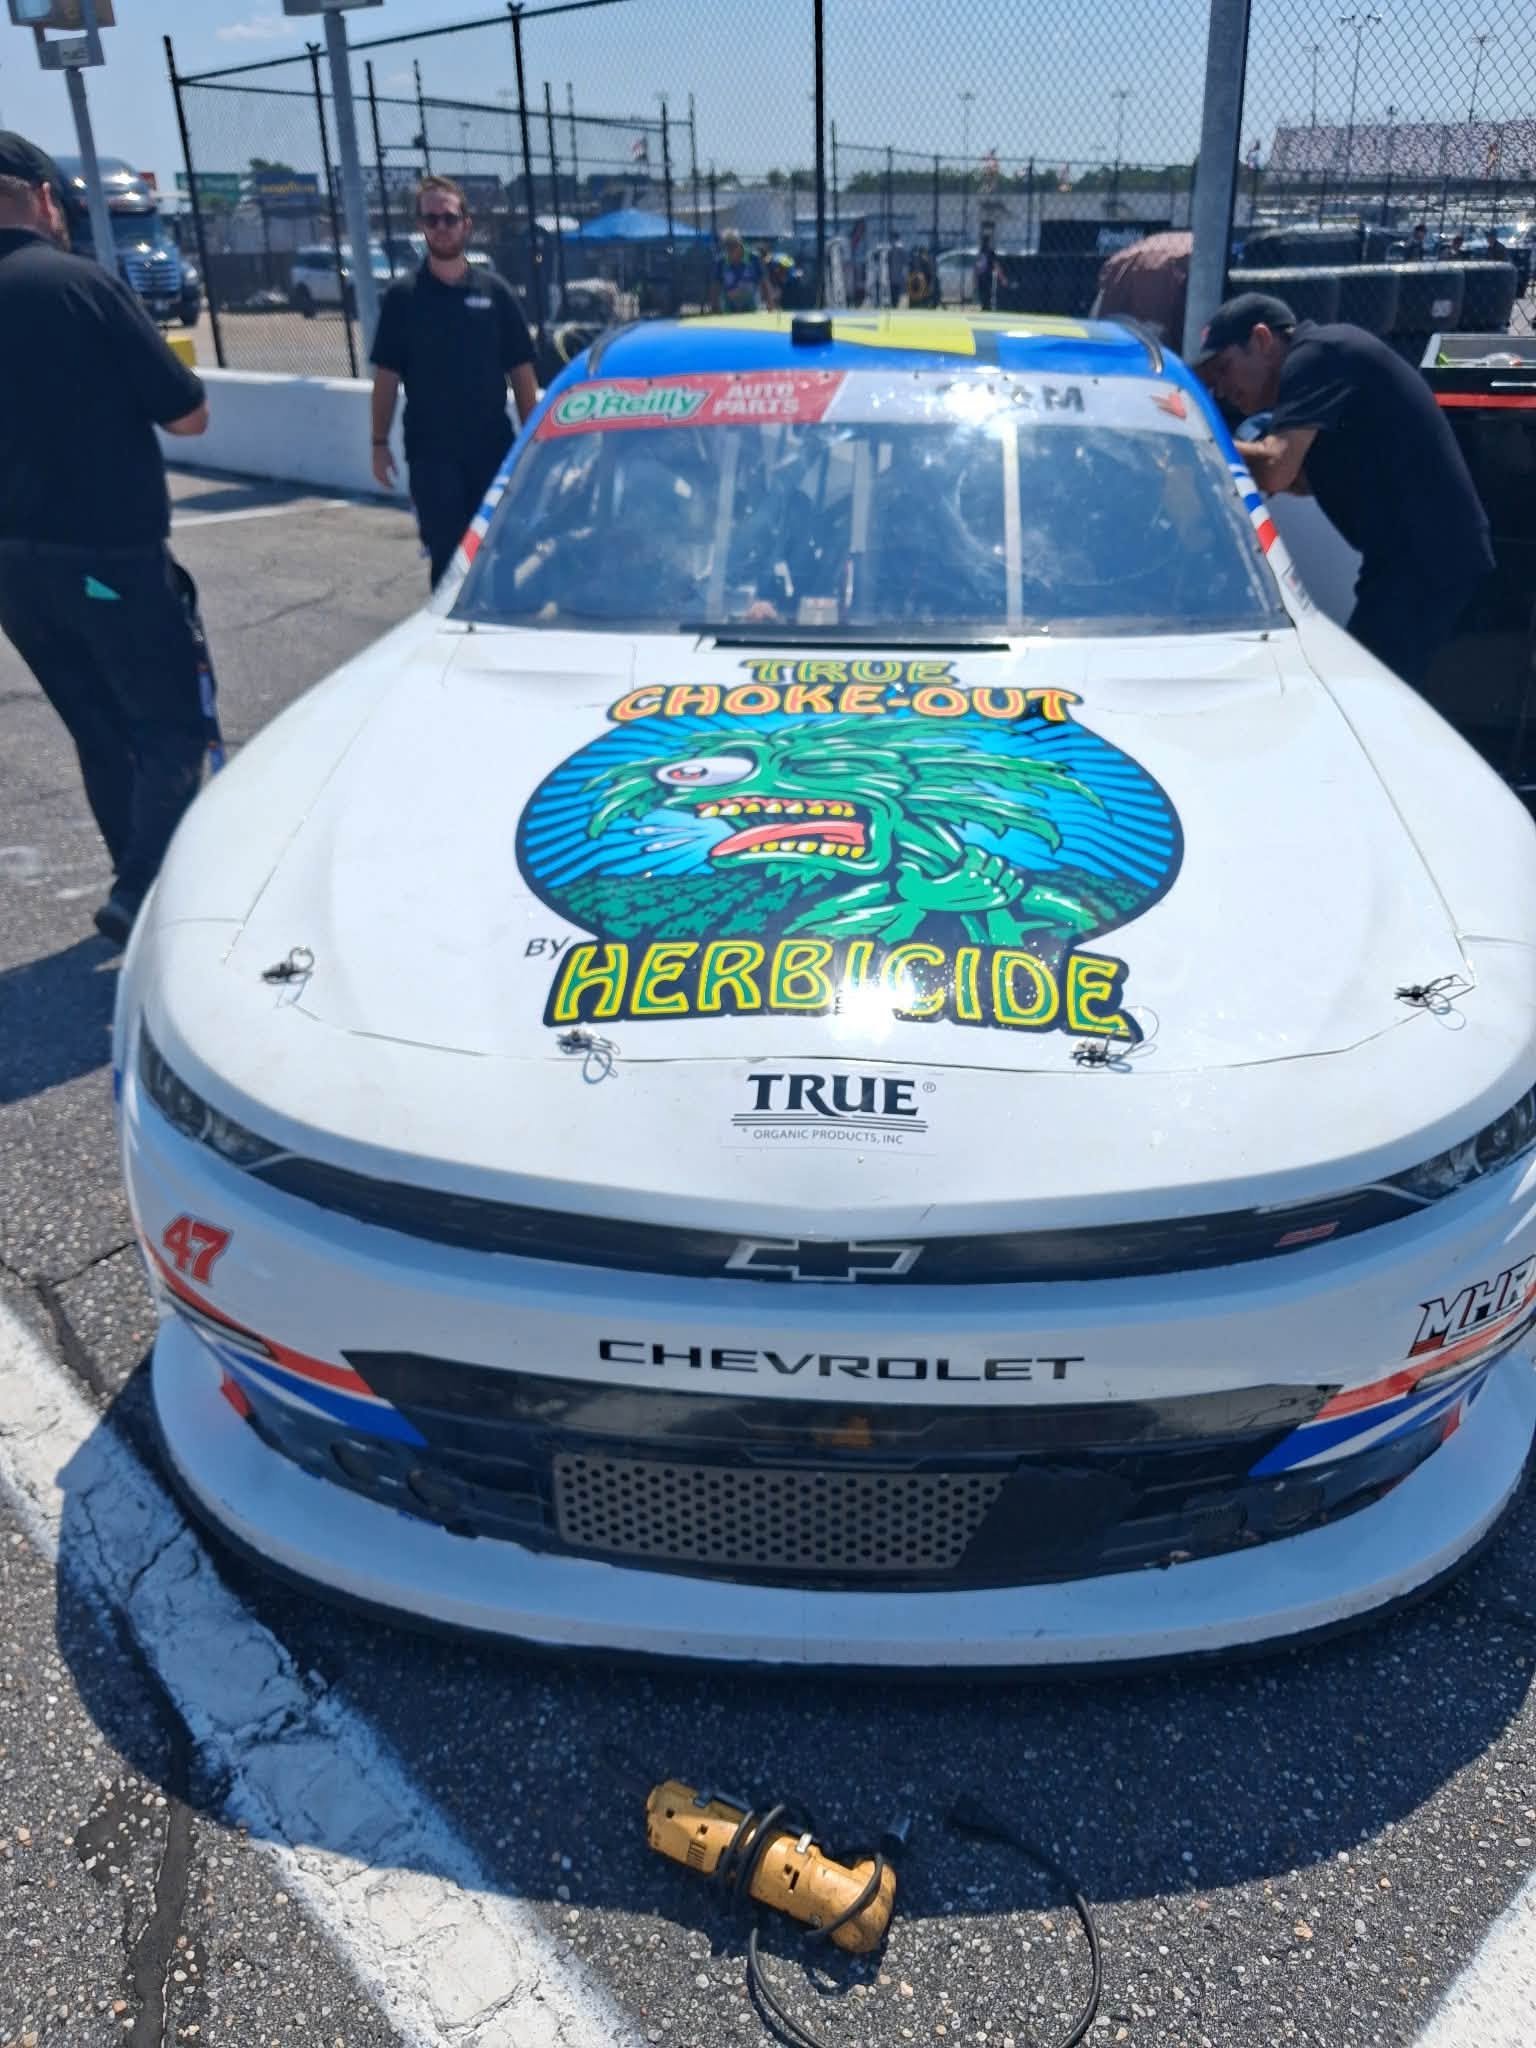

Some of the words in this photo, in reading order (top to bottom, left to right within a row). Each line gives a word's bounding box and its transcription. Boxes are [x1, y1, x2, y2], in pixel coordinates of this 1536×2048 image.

[557, 387, 709, 424] O'Reilly
[712, 397, 800, 417] PARTS
[725, 382, 795, 398] AUTO
[743, 659, 955, 684] TRUE
[612, 684, 1083, 722] CHOKE-OUT
[524, 936, 571, 959] BY
[553, 937, 1131, 1035] HERBICIDE
[747, 1074, 919, 1117] TRUE
[753, 1127, 809, 1140] ORGANIC
[812, 1130, 880, 1144] PRODUCTS,
[883, 1134, 904, 1145] INC
[162, 1215, 234, 1285] 47
[599, 1339, 1085, 1381] CHEVROLET
